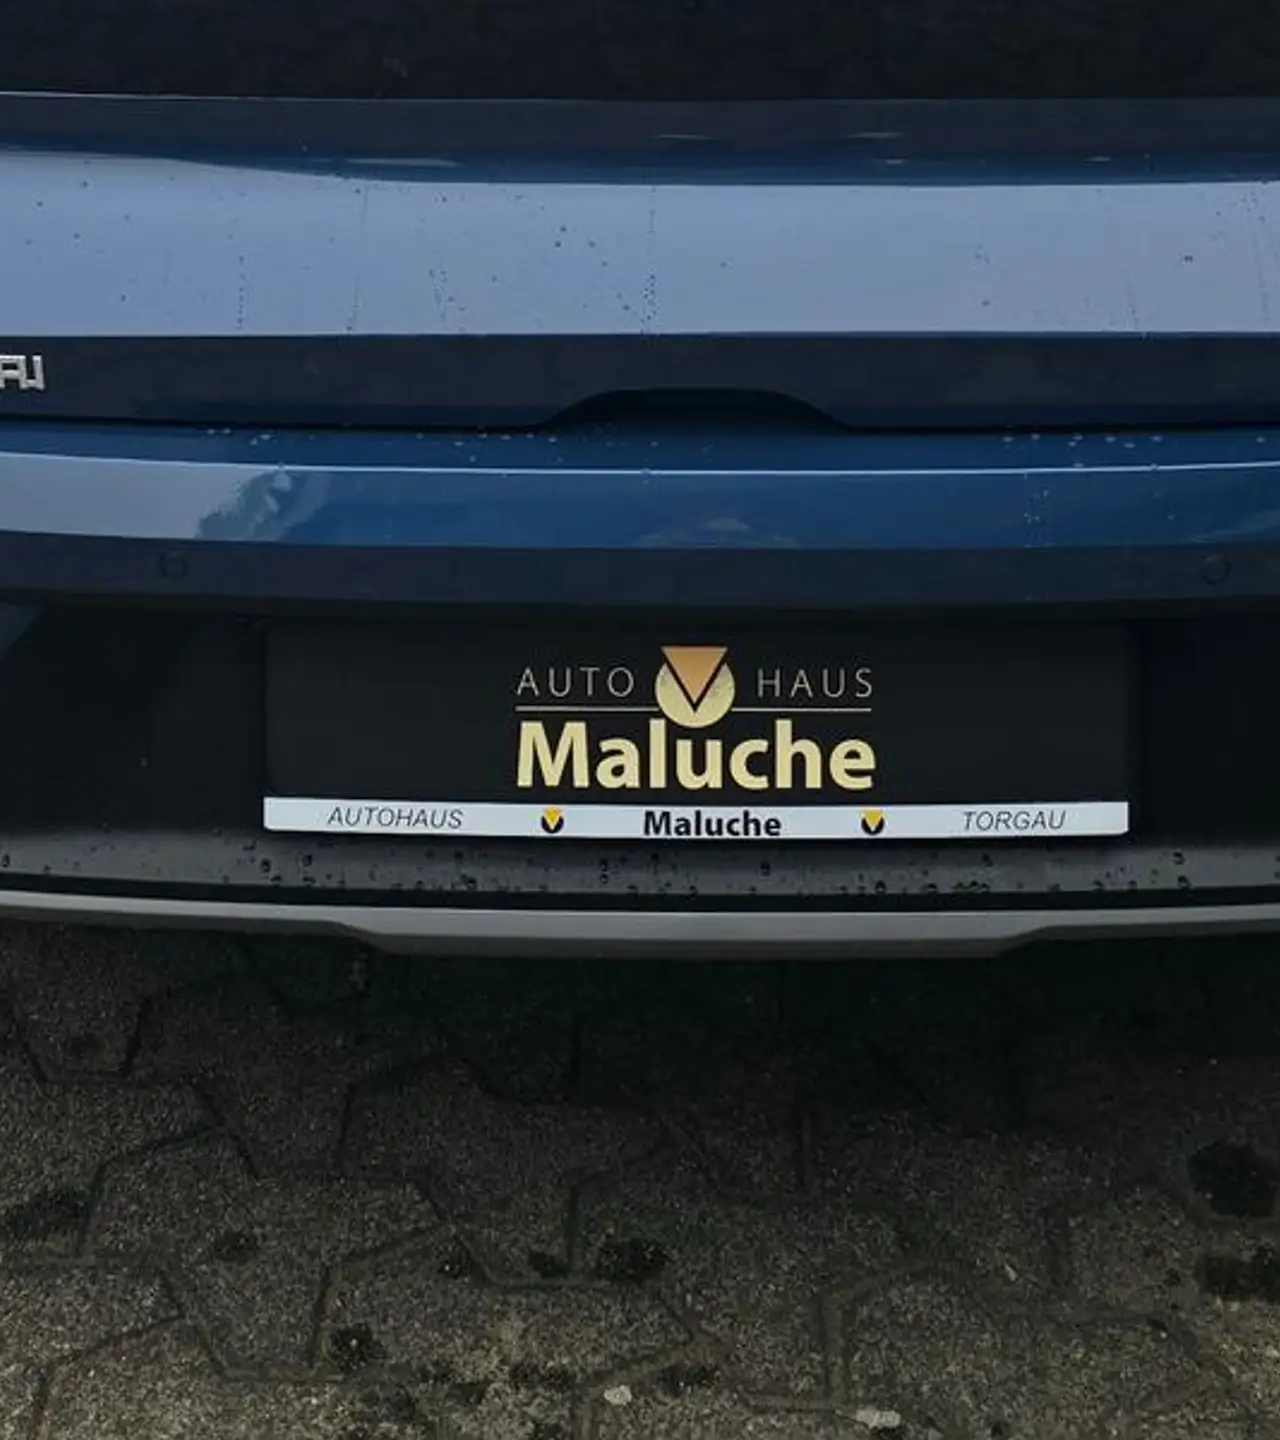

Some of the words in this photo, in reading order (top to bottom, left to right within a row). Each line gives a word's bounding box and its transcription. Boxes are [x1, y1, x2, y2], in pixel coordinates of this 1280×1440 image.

[516, 666, 636, 698] AUTO
[756, 667, 874, 699] HAUS
[516, 717, 877, 790] Maluche
[326, 805, 465, 830] AUTOHAUS
[643, 808, 782, 838] Maluche
[962, 809, 1067, 832] TORGAU
